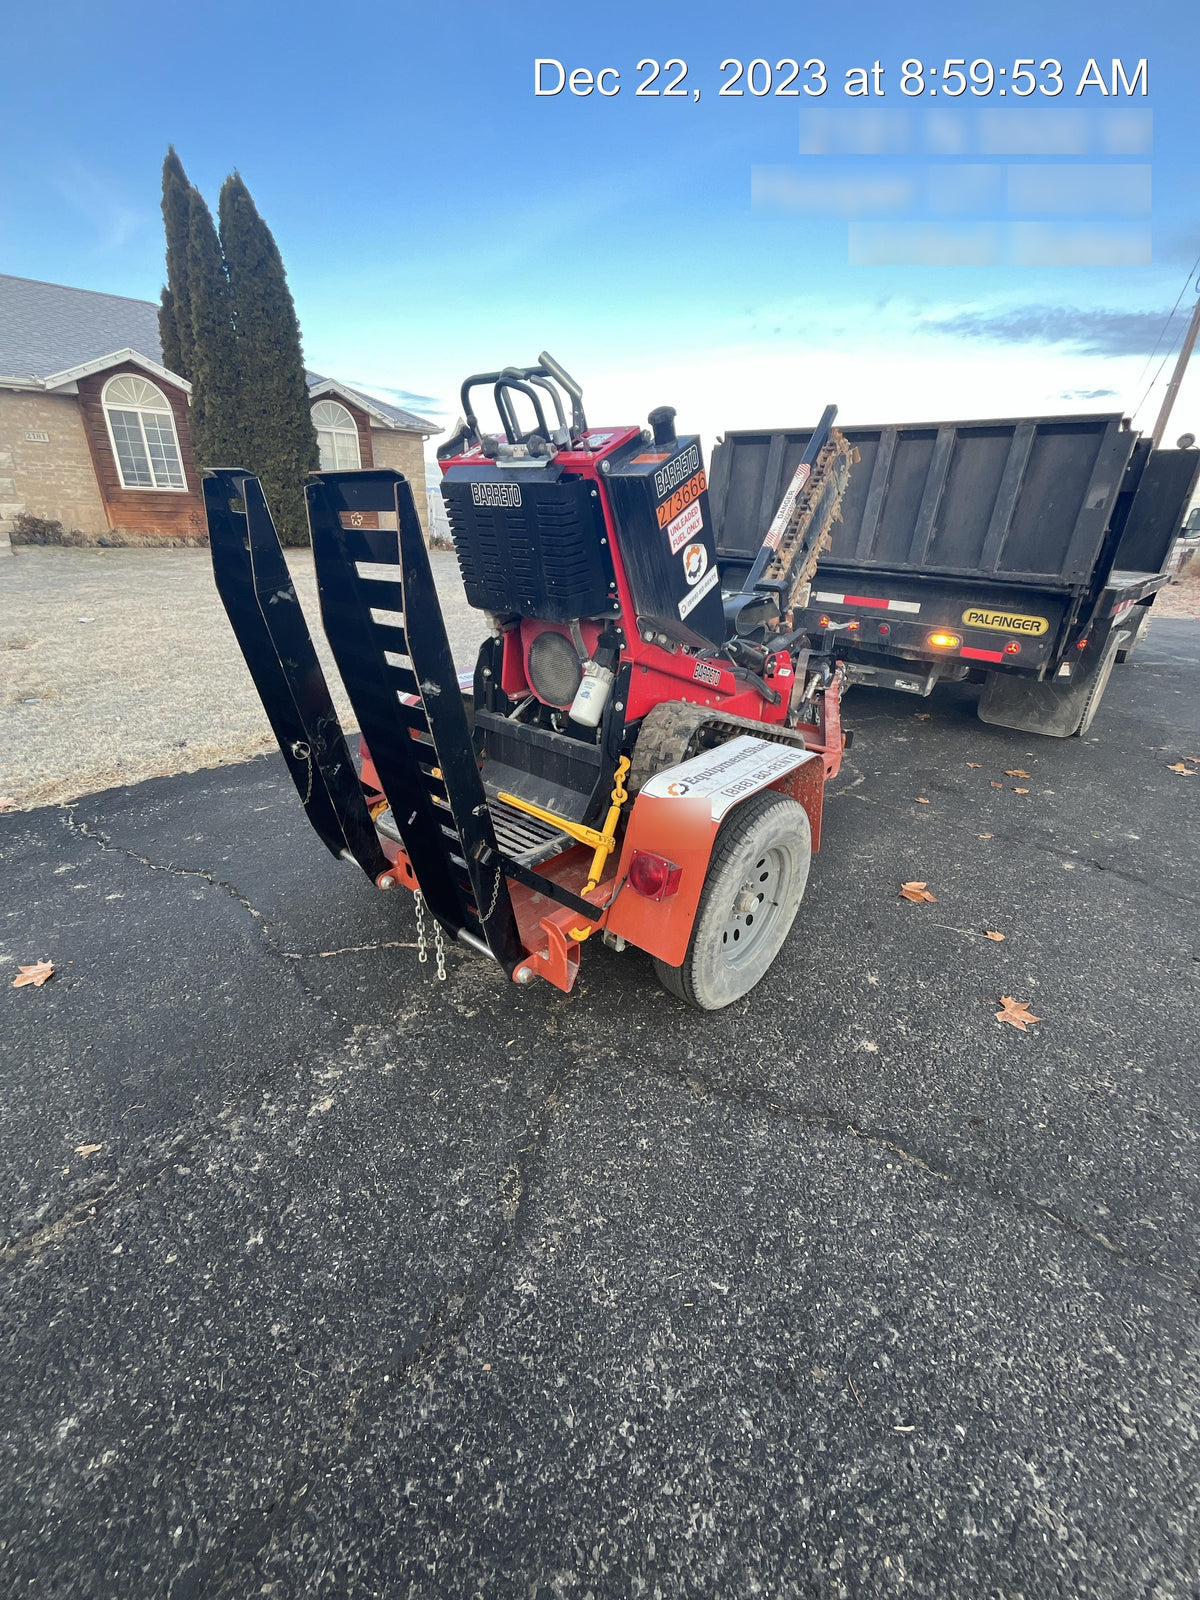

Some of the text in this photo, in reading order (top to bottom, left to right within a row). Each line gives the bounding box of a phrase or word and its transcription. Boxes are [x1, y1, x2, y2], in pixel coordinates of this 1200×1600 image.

[654, 444, 700, 498] BARRETO
[471, 482, 522, 507] BARRETO
[657, 471, 707, 528] 273666
[777, 490, 795, 519] DANGER
[670, 505, 699, 537] UNLEADED
[672, 521, 701, 549] FUEL ONLY
[967, 612, 1042, 632] PALFINGER
[693, 662, 721, 686] BARRETO
[720, 753, 801, 799] (888) 80-RENTS
